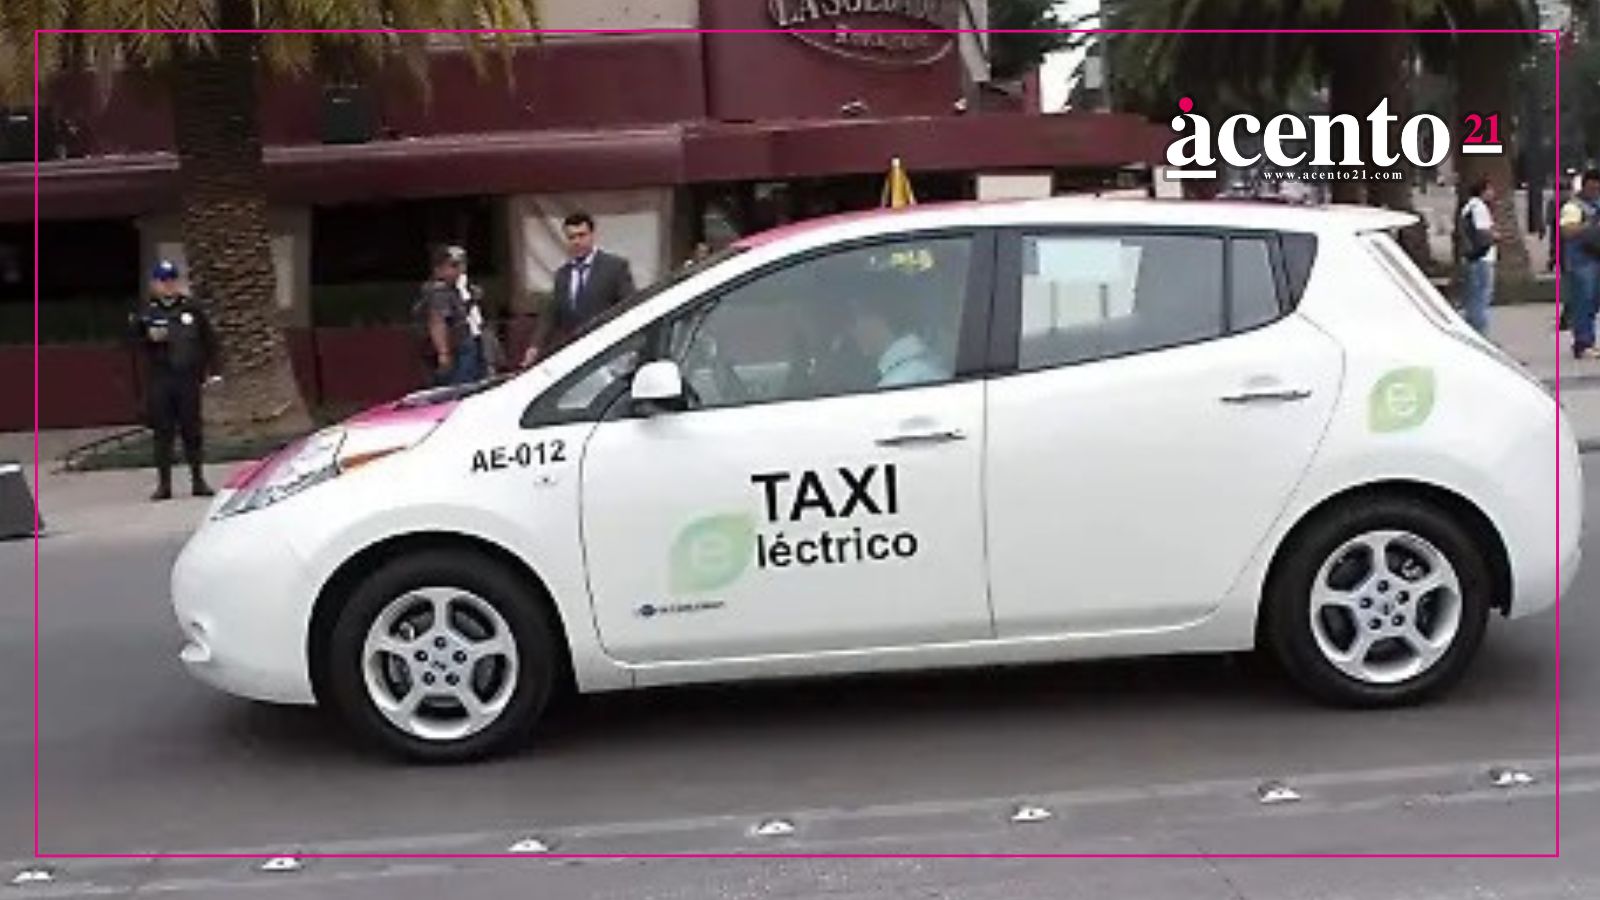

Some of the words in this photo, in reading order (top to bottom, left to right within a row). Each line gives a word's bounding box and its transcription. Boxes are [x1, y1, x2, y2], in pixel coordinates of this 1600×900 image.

[470, 438, 566, 473] AE-012
[750, 463, 898, 523] TAXI
[757, 527, 919, 569] léctrico
